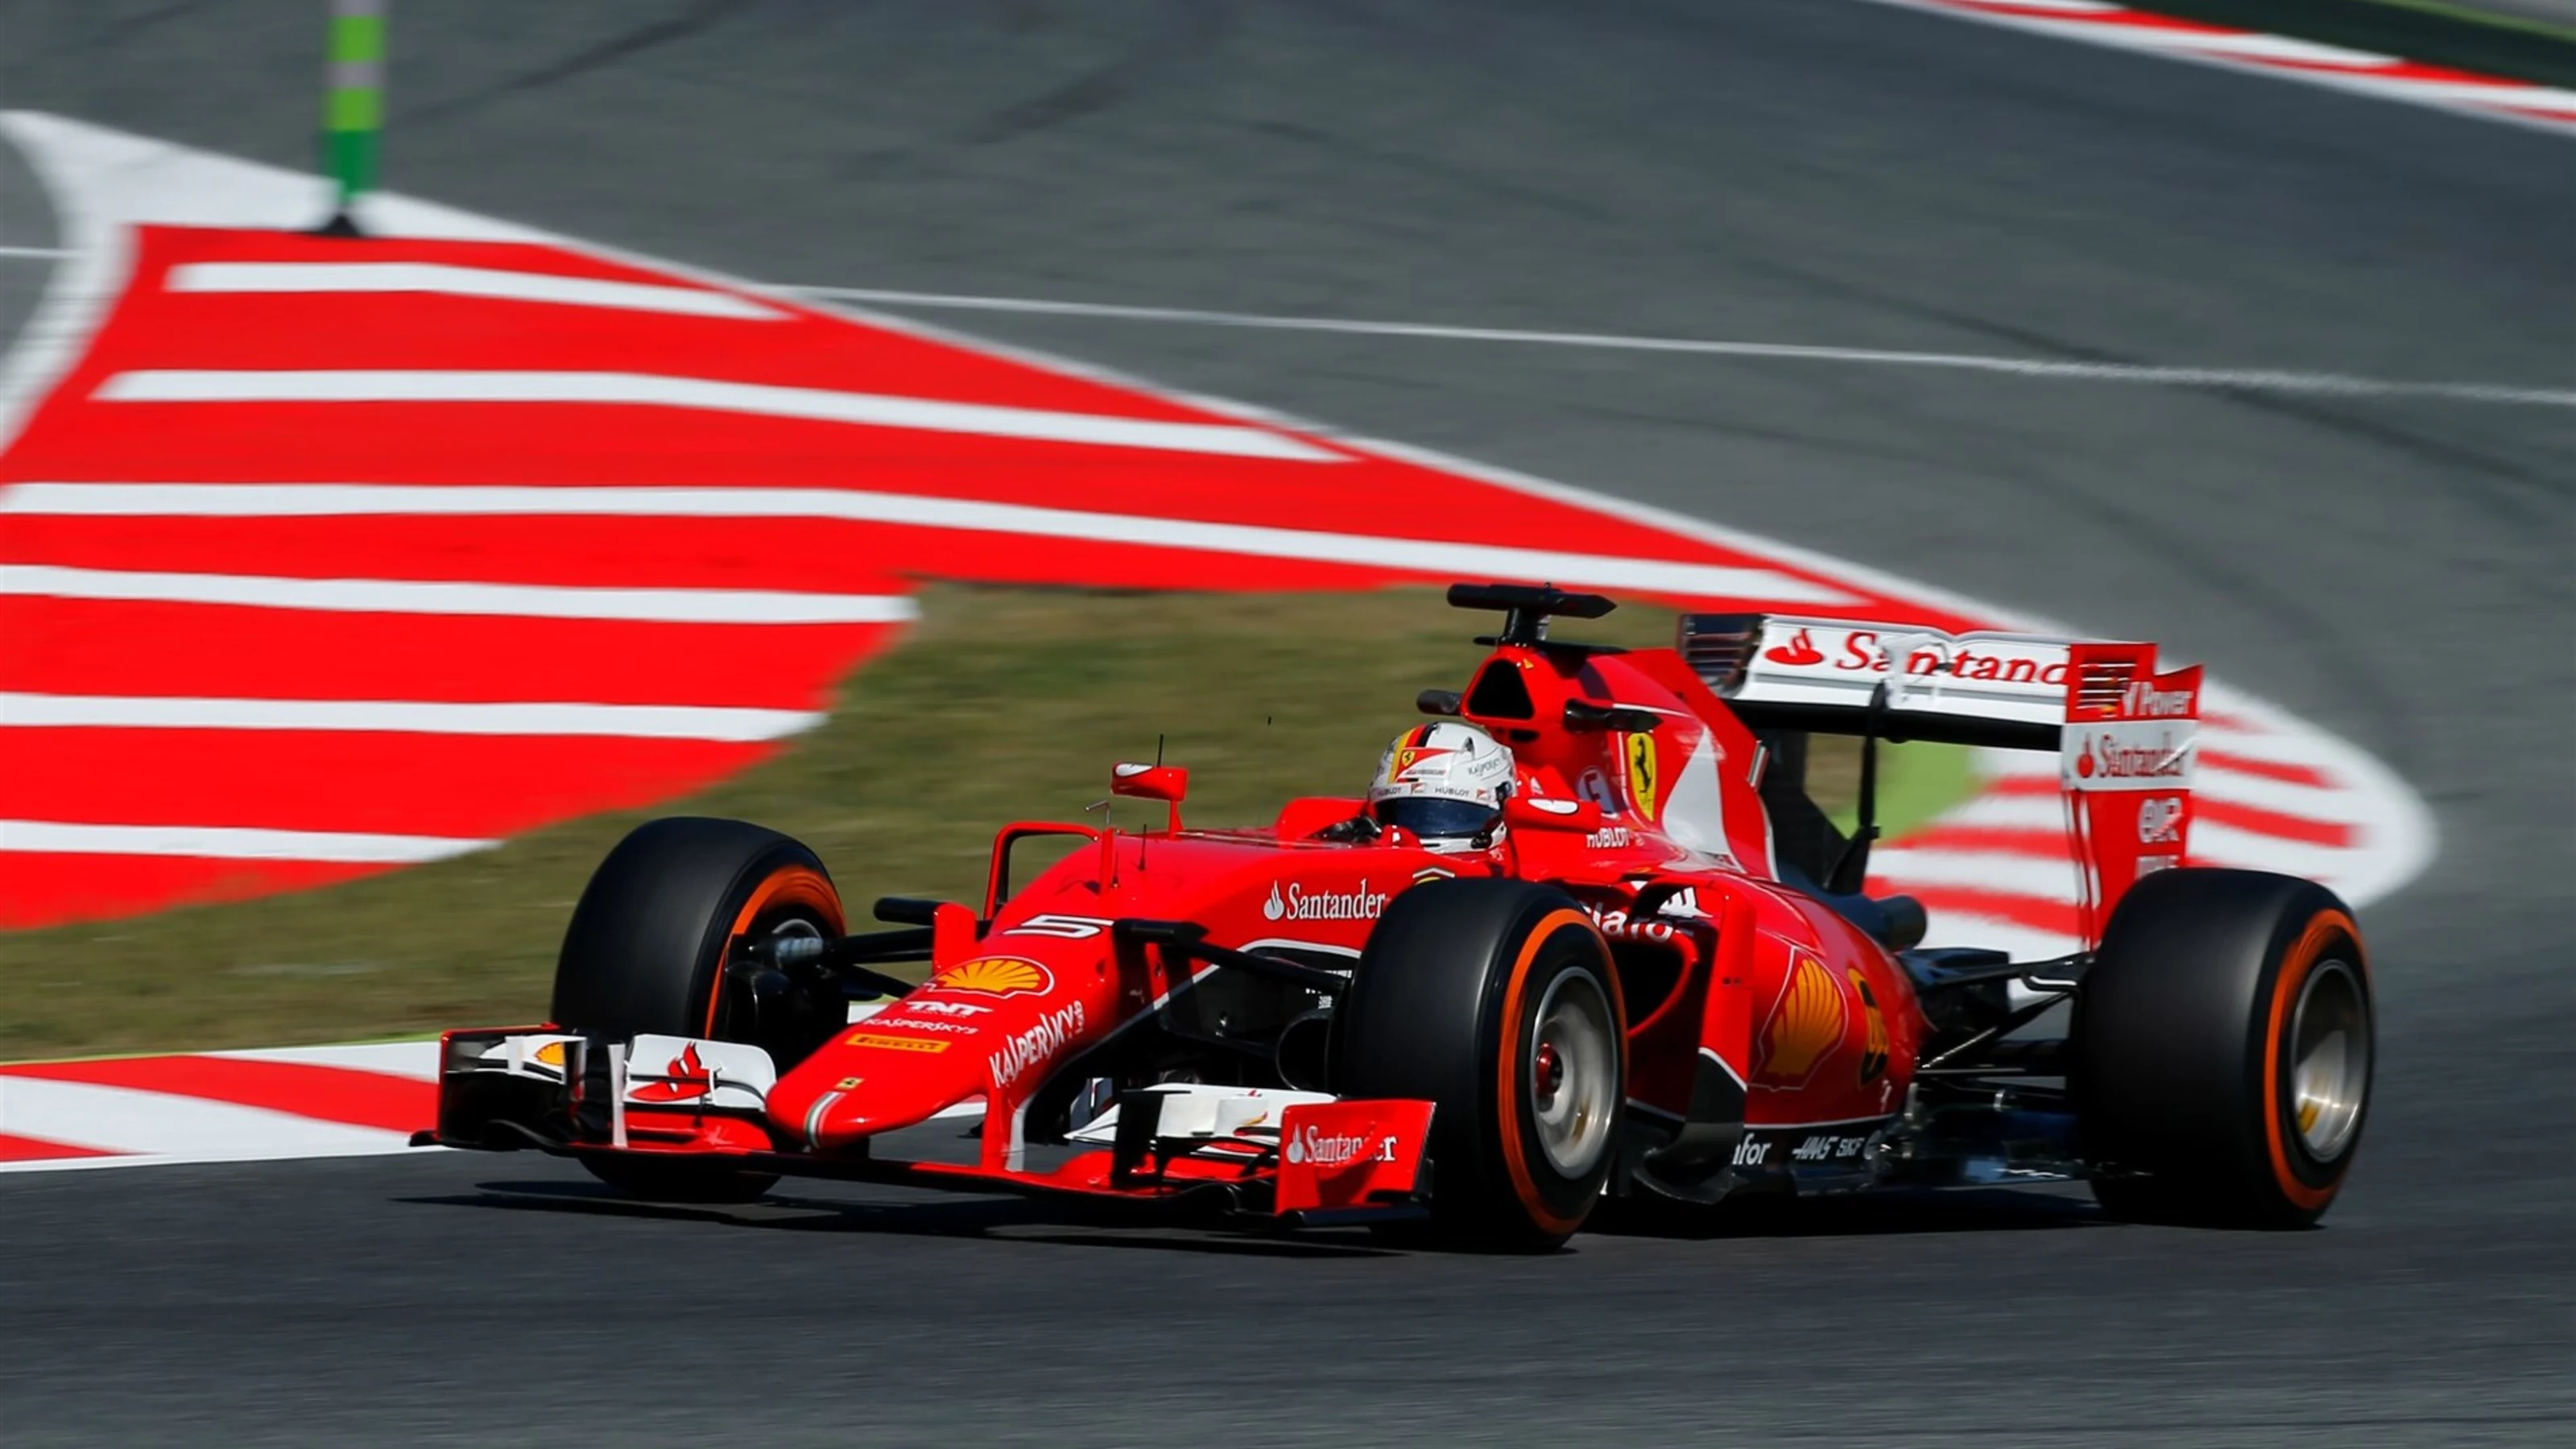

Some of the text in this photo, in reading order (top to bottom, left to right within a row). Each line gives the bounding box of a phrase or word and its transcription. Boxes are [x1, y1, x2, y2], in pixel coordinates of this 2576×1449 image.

[1287, 878, 1385, 920] Santander
[1003, 915, 1114, 939] 5
[1582, 902, 1674, 943] laro
[905, 1001, 994, 1016] TNT
[989, 1005, 1075, 1089] KASPERSKY
[1305, 1125, 1397, 1163] Santaner
